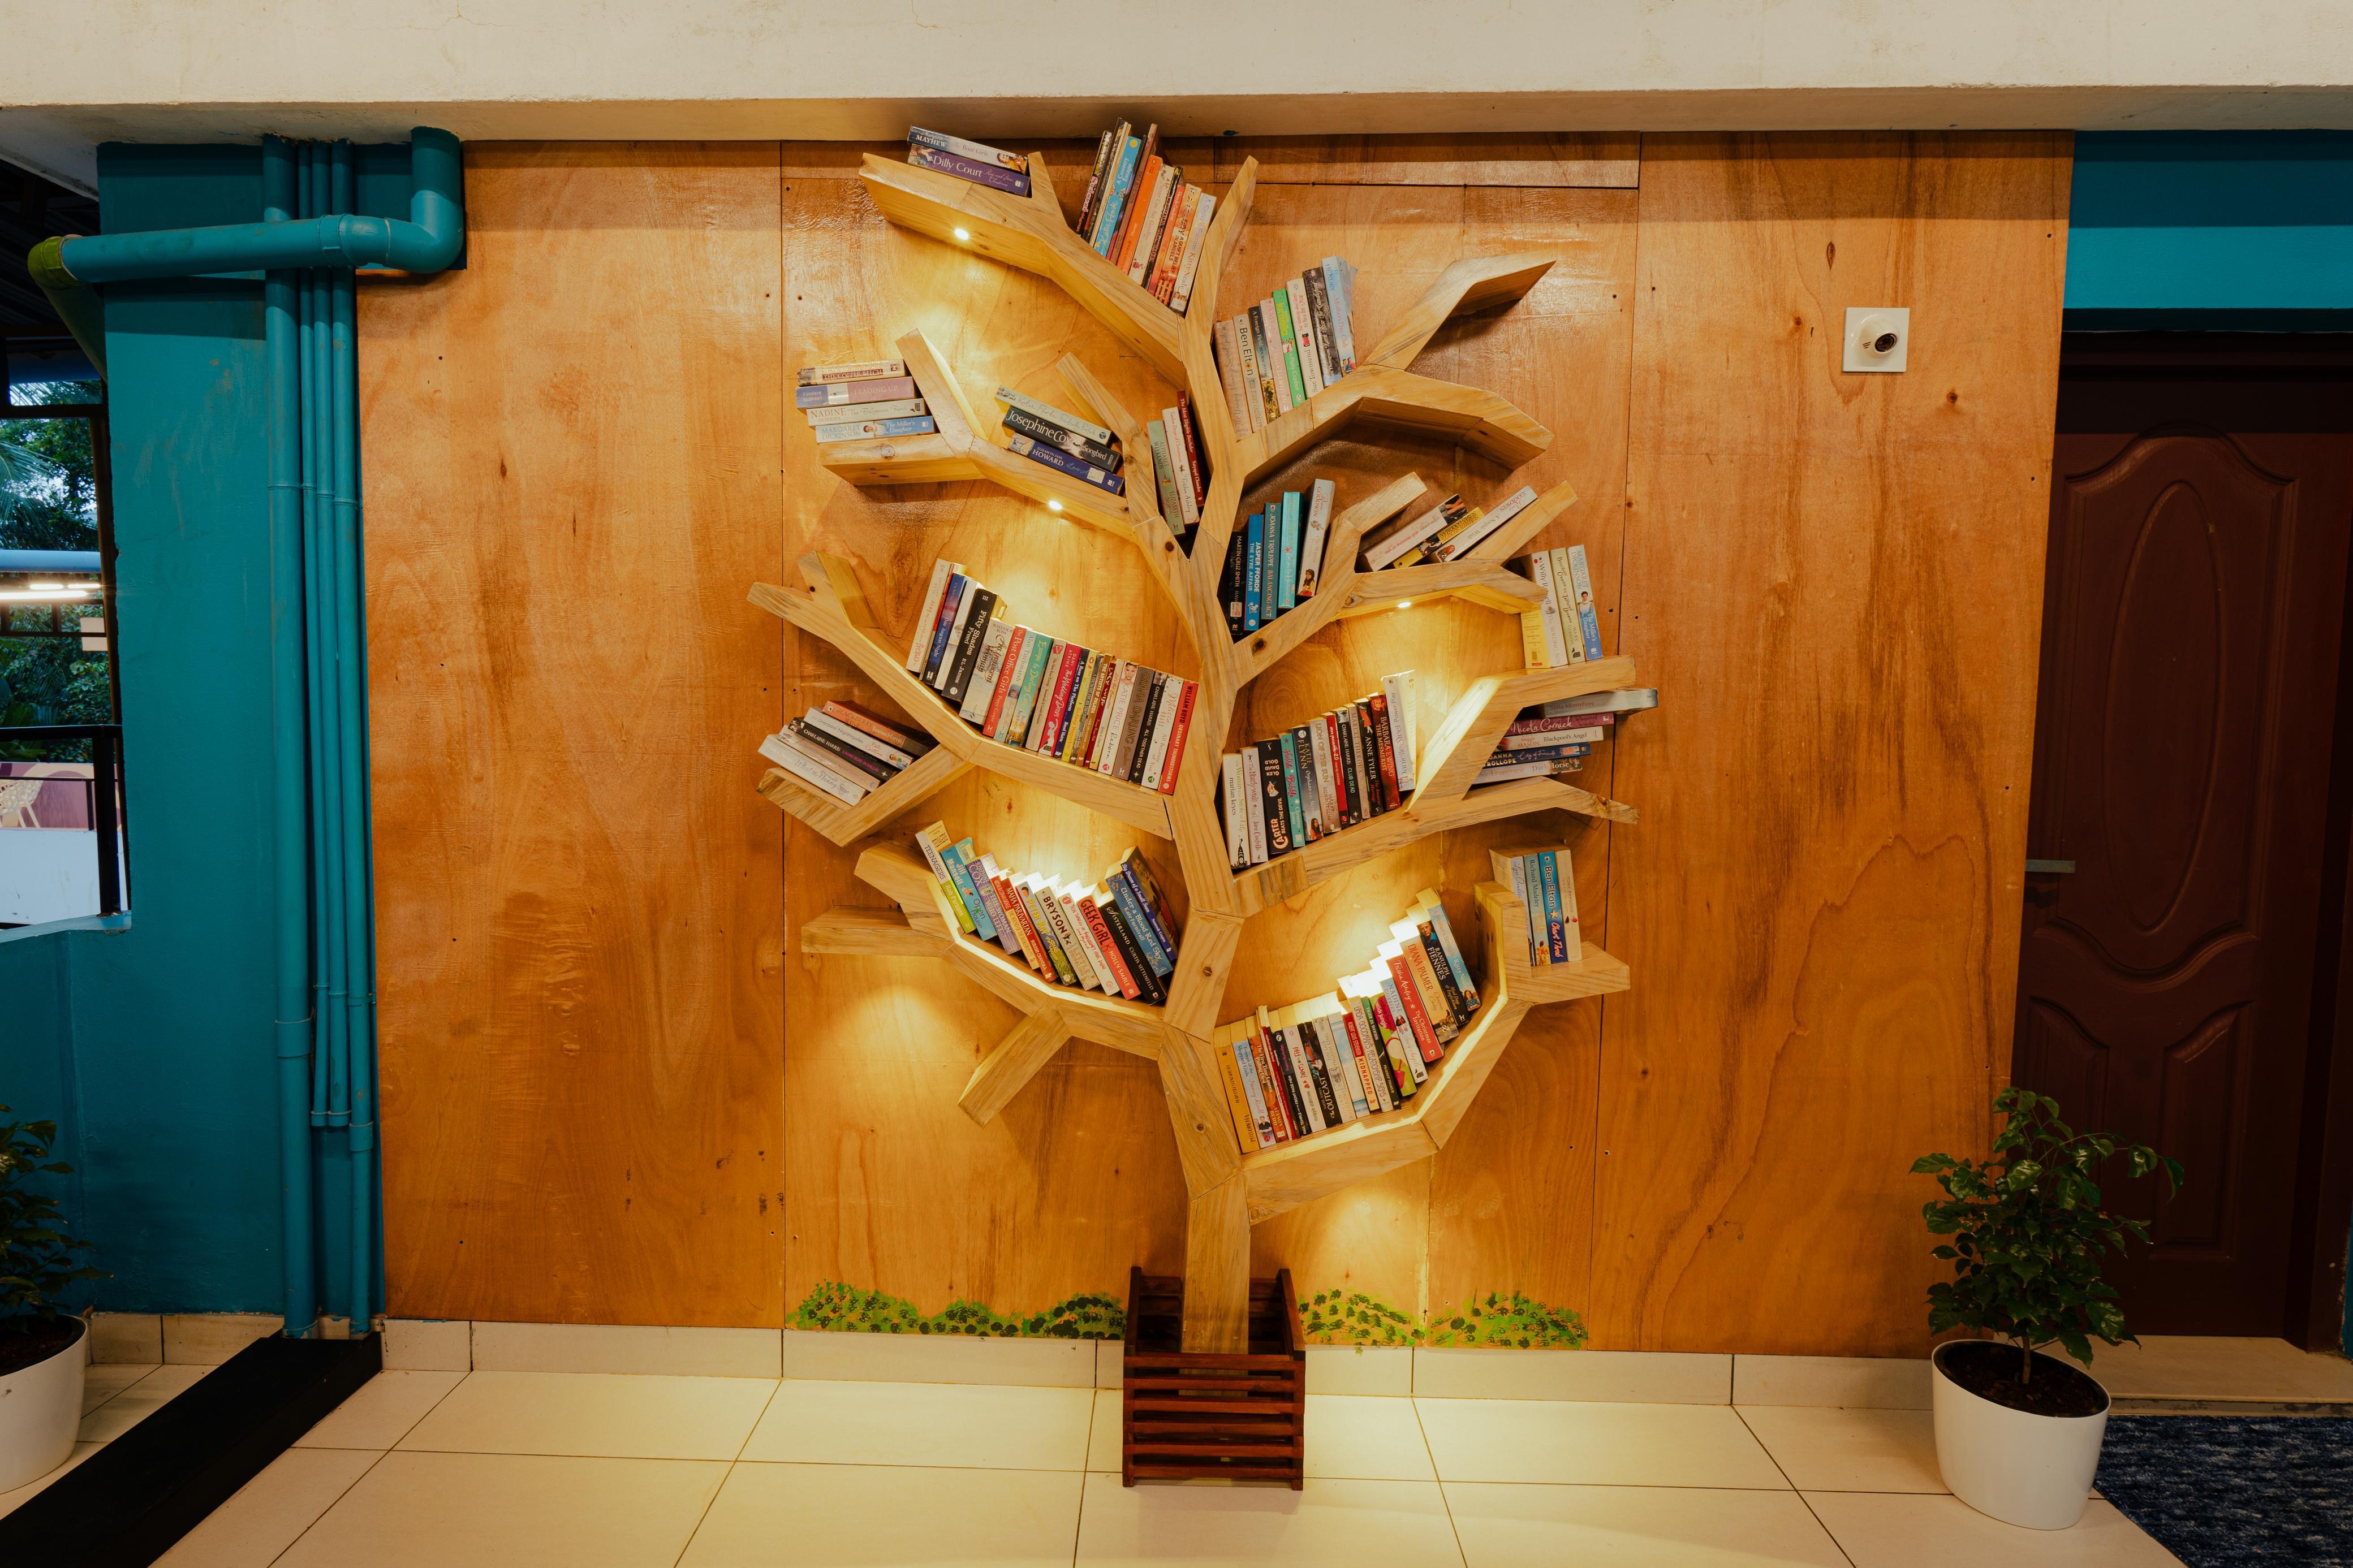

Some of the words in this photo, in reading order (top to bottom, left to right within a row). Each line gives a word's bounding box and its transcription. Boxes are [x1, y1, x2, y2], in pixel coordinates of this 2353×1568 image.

[915, 134, 947, 148] MAYHEW
[932, 155, 954, 171] Dilly
[955, 162, 983, 177] Court
[1117, 157, 1130, 180] Country
[1122, 162, 1132, 182] Escape
[1129, 188, 1137, 204] WINGS
[1168, 241, 1178, 261] ANGELS
[1325, 264, 1335, 292] HENDRY
[1333, 297, 1343, 322] Mother's
[1304, 348, 1316, 379] Townsend
[854, 386, 886, 395] TRADING
[811, 408, 845, 418] NADINE
[822, 425, 860, 434] MARGARET
[822, 431, 861, 440] DICKINSON
[1005, 408, 1056, 440] Josephine
[1052, 429, 1072, 446] Cox
[1032, 448, 1065, 467] HOWARD
[1037, 447, 1054, 456] ELIZABETH
[1081, 444, 1107, 461] Songbird
[1153, 440, 1163, 469] WEEKENDS
[1159, 440, 1169, 466] ALPHABET
[1169, 491, 1179, 518] ELIZABETH
[1498, 491, 1526, 512] GOODWIN
[1466, 529, 1480, 540] Wish
[1478, 516, 1496, 531] Simple
[1538, 563, 1548, 581] Willy
[1571, 551, 1581, 590] DICKINSON
[1576, 550, 1588, 588] MARGARET
[973, 609, 987, 629] Fifty
[963, 626, 974, 645] Freed
[966, 629, 980, 656] Shades
[1118, 681, 1132, 705] KATIE
[1182, 685, 1193, 709] WILLIAM
[835, 707, 873, 729] BLACKBERRY
[843, 716, 861, 728] WINE
[1112, 707, 1123, 730] PRICE
[1179, 709, 1187, 723] BOYD
[1350, 712, 1359, 740] MARCEL
[1509, 719, 1538, 734] Nicola
[1539, 715, 1572, 732] Cornick
[803, 728, 826, 744] CHARLAINE
[825, 740, 841, 751] HARRIS
[817, 717, 838, 731] Liverpool
[837, 727, 864, 744] Nightingales
[1174, 724, 1183, 747] ORDINARY
[1380, 716, 1391, 750] BARBARA
[1542, 733, 1571, 743] Blackpool's
[1139, 737, 1147, 758] TOGETHER
[1297, 739, 1307, 769] FLYNN
[1304, 743, 1312, 764] KATIE
[1364, 736, 1373, 755] ANNE
[1377, 737, 1387, 771] MESMERIST
[1516, 740, 1540, 748] MASON
[1165, 748, 1178, 782] THUNDERSTORMS
[1354, 741, 1363, 774] THEROUX
[1368, 756, 1376, 779] TYLER
[1385, 751, 1394, 776] EWING
[1490, 766, 1525, 777] Francome
[924, 844, 946, 880] TEENAGERS
[946, 858, 964, 885] Mansell
[955, 862, 967, 875] Jill
[1529, 859, 1537, 882] Richard
[967, 863, 984, 887] COX
[1544, 866, 1553, 883] Ben
[1546, 884, 1557, 908] Elton
[1005, 887, 1018, 905] MAHA
[1012, 903, 1032, 936] PARIVARTAN
[1042, 895, 1067, 934] BRYSON
[1123, 906, 1133, 919] Kate
[1129, 918, 1145, 941] Furnivall
[1550, 922, 1561, 940] Chart
[1029, 939, 1040, 953] SURESH
[1036, 952, 1048, 970] CHANDRA
[1434, 946, 1450, 975] RANULPH
[1553, 940, 1563, 958] Throb
[1128, 946, 1140, 964] CURTIS
[1137, 963, 1154, 990] SITTENFELD
[1407, 943, 1423, 966] DIANA
[1417, 966, 1433, 991] PALMER
[1427, 946, 1446, 980] FIENNES
[1388, 983, 1403, 1013] NADINE
[1371, 1024, 1380, 1040] WOODS
[1412, 1016, 1426, 1041] Invitation
[1418, 1018, 1432, 1044] Christmas
[1352, 1039, 1361, 1056] STEVENSON
[1358, 1058, 1373, 1095] KIDNAPPED
[1318, 1075, 1334, 1111] OUTCAST
